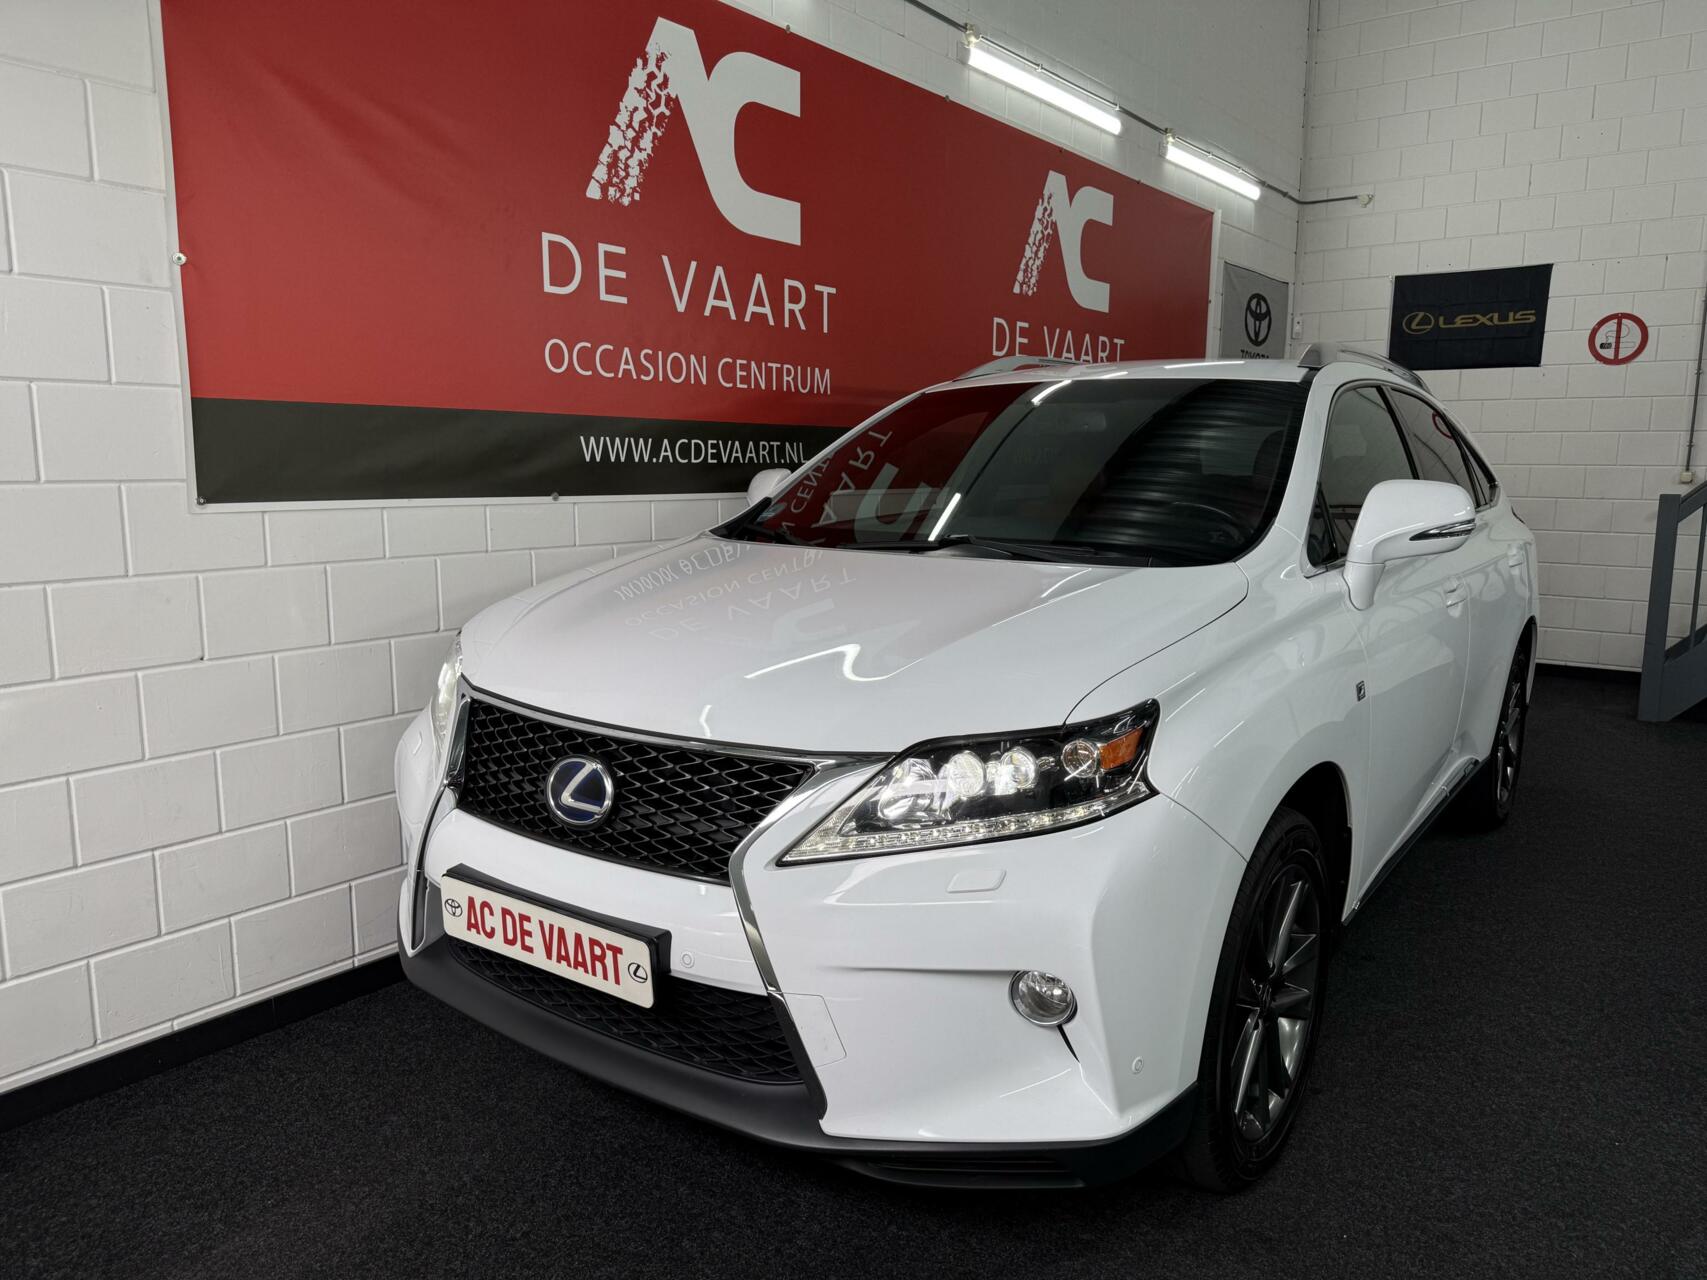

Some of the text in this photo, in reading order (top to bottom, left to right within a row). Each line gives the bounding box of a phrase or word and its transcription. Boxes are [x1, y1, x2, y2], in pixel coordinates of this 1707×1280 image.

[541, 231, 837, 333] DE VAART
[992, 317, 1125, 364] DE VAART
[1438, 310, 1537, 328] LEXUS
[544, 338, 831, 395] OCCASION CENTRUM
[580, 435, 808, 464] WWW.ACDEVAART.NL
[466, 896, 623, 986] AC DE VAART
